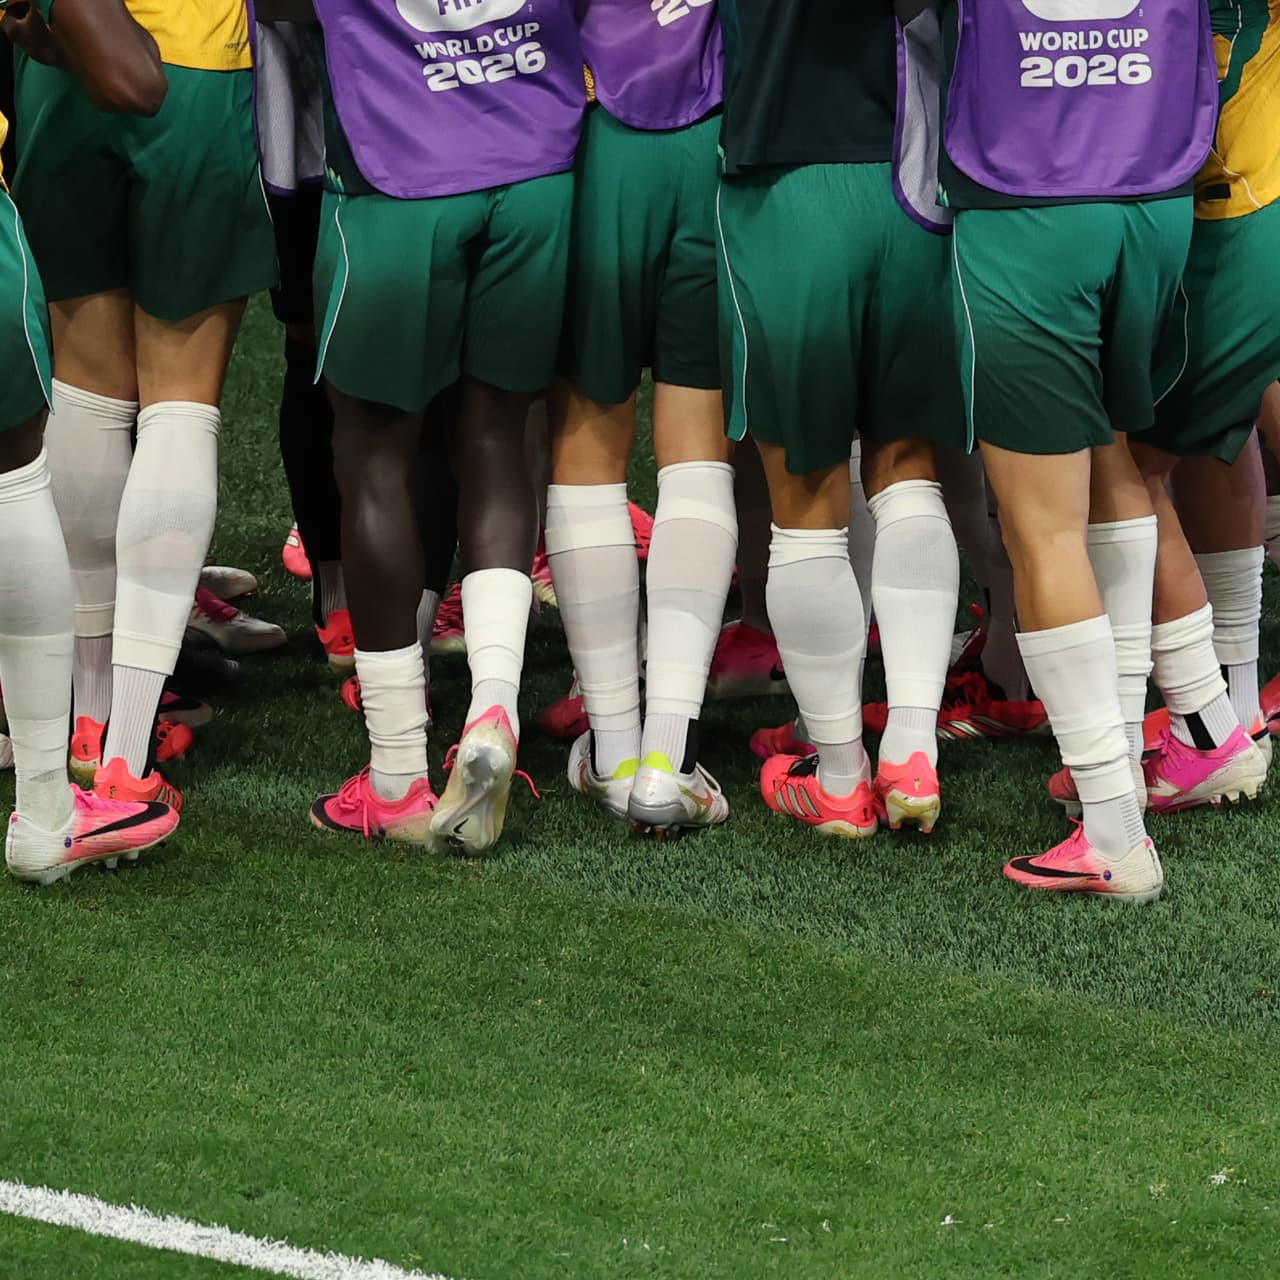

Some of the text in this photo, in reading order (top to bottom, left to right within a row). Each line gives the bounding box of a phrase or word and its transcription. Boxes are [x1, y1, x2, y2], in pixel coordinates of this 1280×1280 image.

[415, 22, 540, 59] WORLD CUP
[1019, 28, 1149, 51] WORLD CUP
[422, 41, 546, 92] 2026
[1019, 53, 1153, 87] 2026
